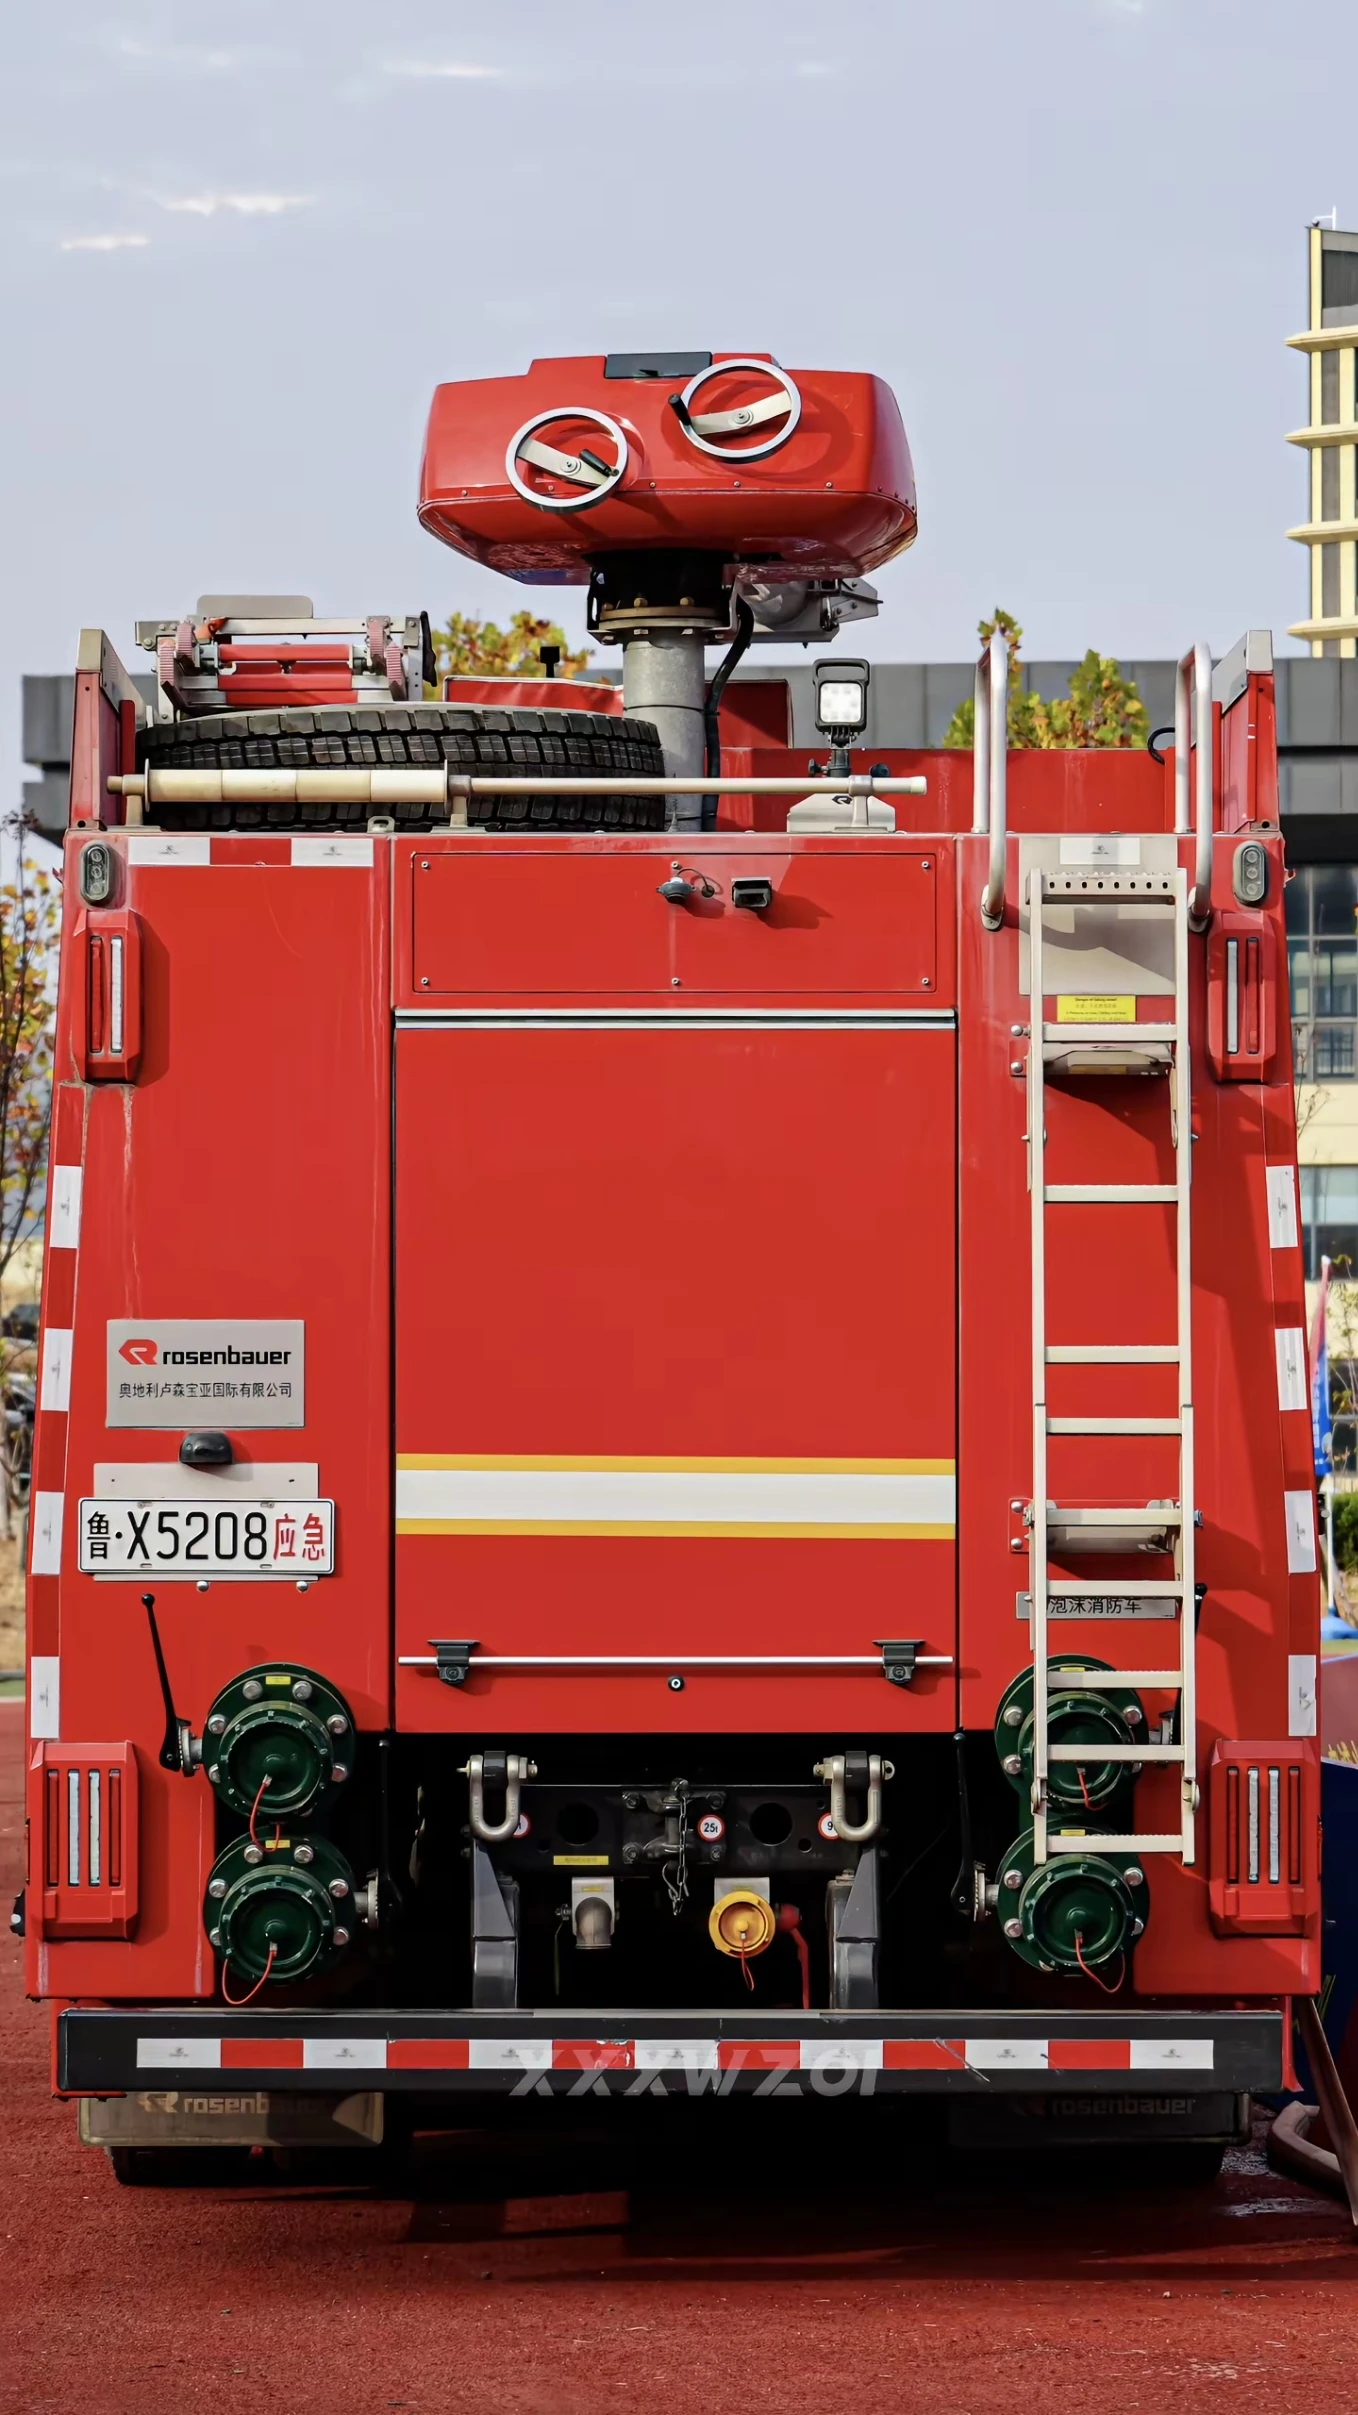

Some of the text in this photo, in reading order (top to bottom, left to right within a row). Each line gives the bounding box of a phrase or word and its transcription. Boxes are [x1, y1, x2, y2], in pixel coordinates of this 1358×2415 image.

[162, 1344, 292, 1365] rosenbauer
[119, 1382, 292, 1398] 奥地利卢森宝亚国际有限公司
[1046, 1598, 1142, 1614] 泡沫消防车
[184, 2092, 320, 2114] rosenb
